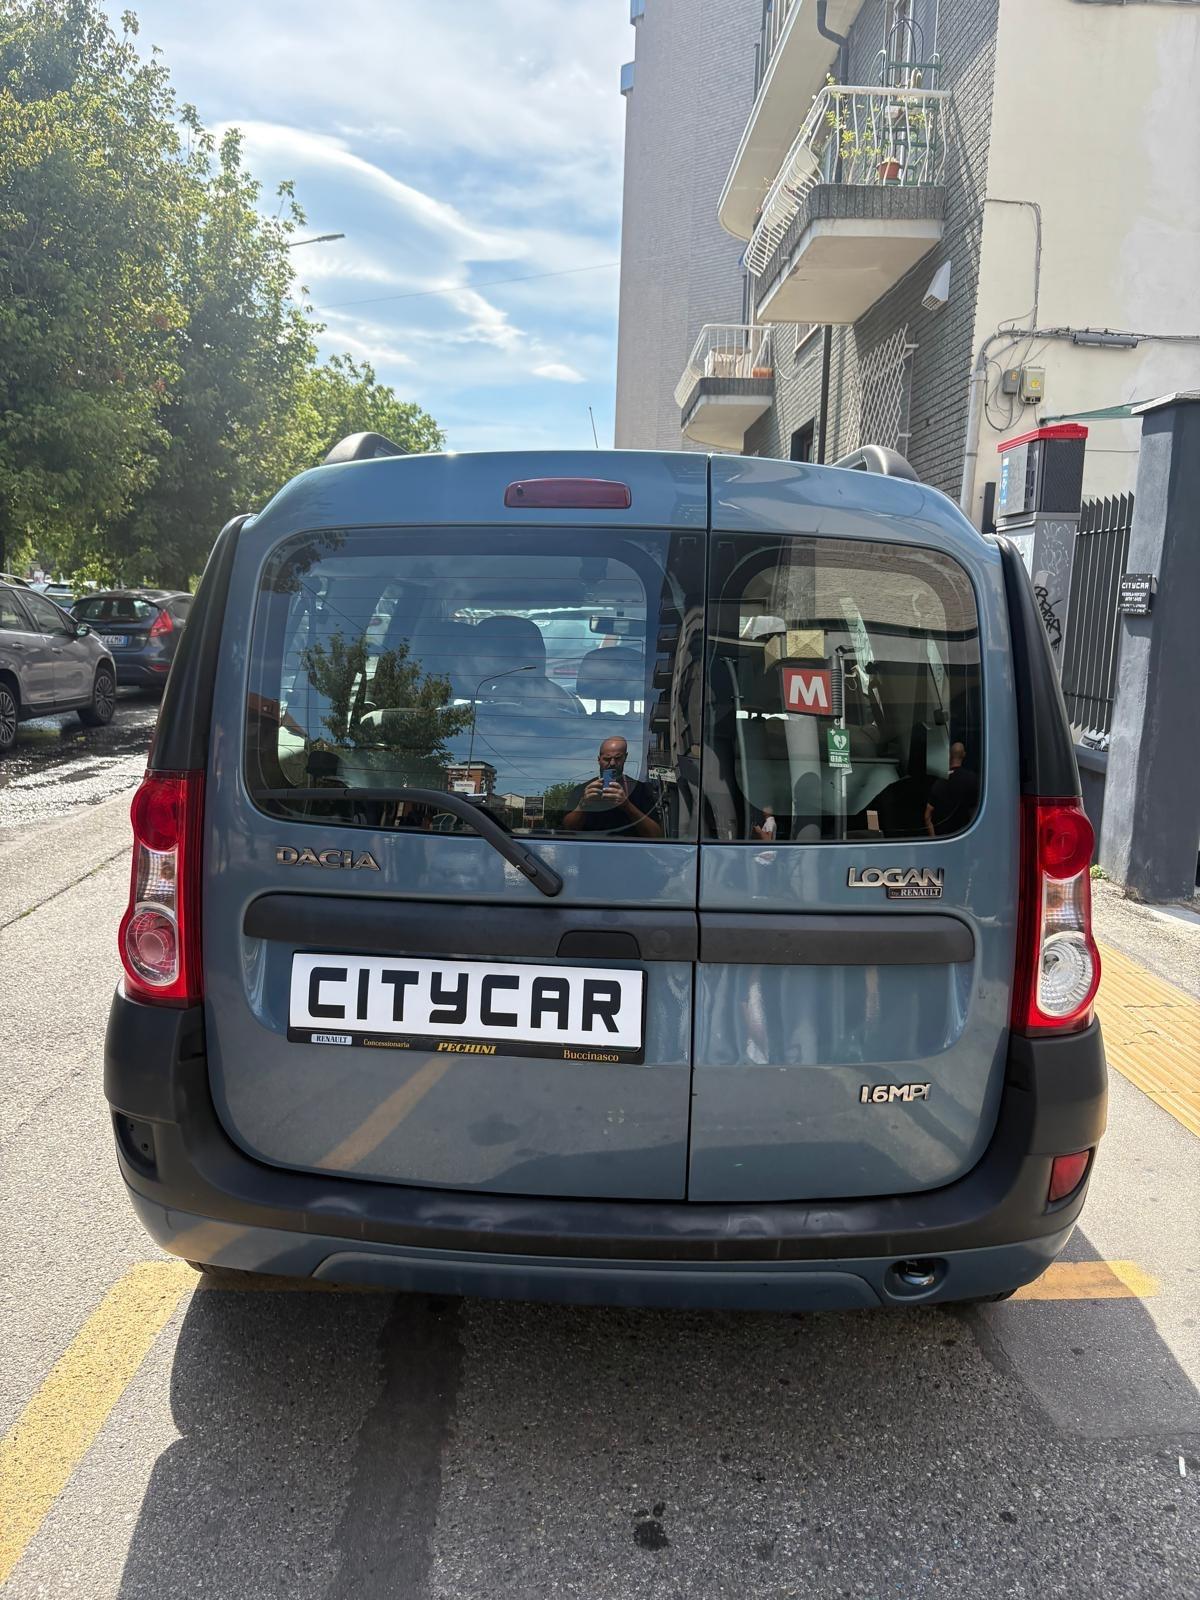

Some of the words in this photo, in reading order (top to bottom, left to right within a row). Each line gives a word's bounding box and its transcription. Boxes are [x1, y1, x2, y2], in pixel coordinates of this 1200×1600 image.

[275, 846, 380, 871] DACIA
[848, 867, 943, 887] LOGAN
[900, 888, 940, 896] RENAULT
[308, 966, 622, 1033] CITYCAR
[316, 1035, 348, 1044] RENAULT
[363, 1038, 410, 1048] Concessionaria
[437, 1042, 497, 1055] PECHINI
[563, 1050, 619, 1062] Buccinasco
